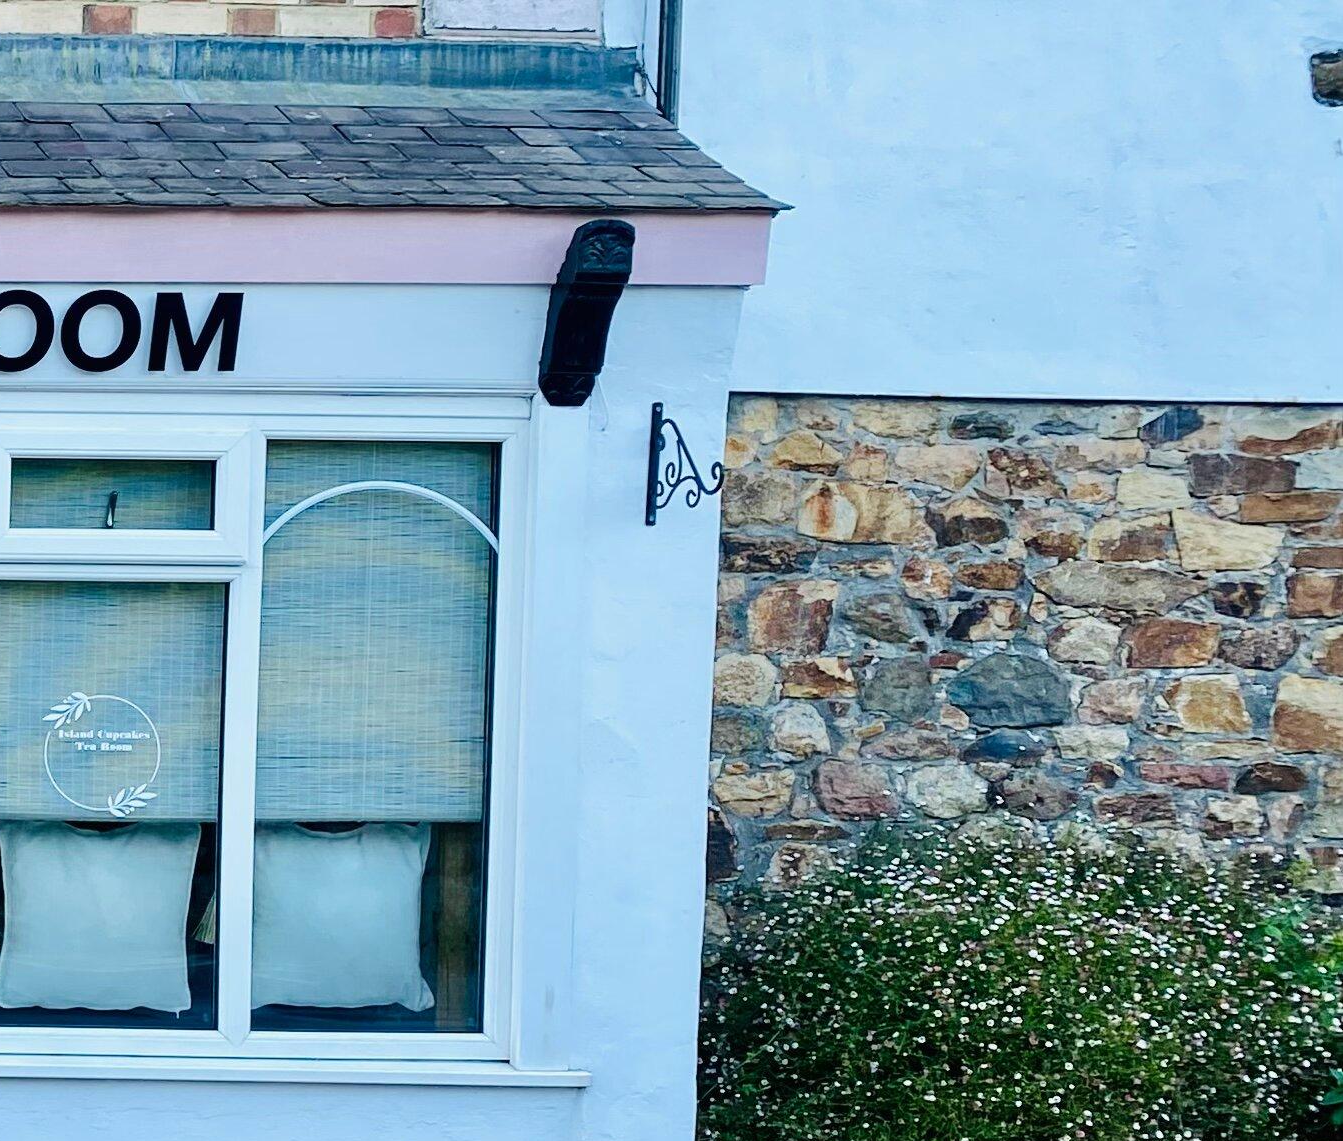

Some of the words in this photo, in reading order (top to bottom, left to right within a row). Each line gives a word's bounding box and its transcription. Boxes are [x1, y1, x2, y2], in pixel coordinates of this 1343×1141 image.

[58, 729, 94, 739] Island
[97, 729, 151, 741] Cupcakes
[74, 741, 97, 751] Tea
[100, 742, 133, 751] Room
